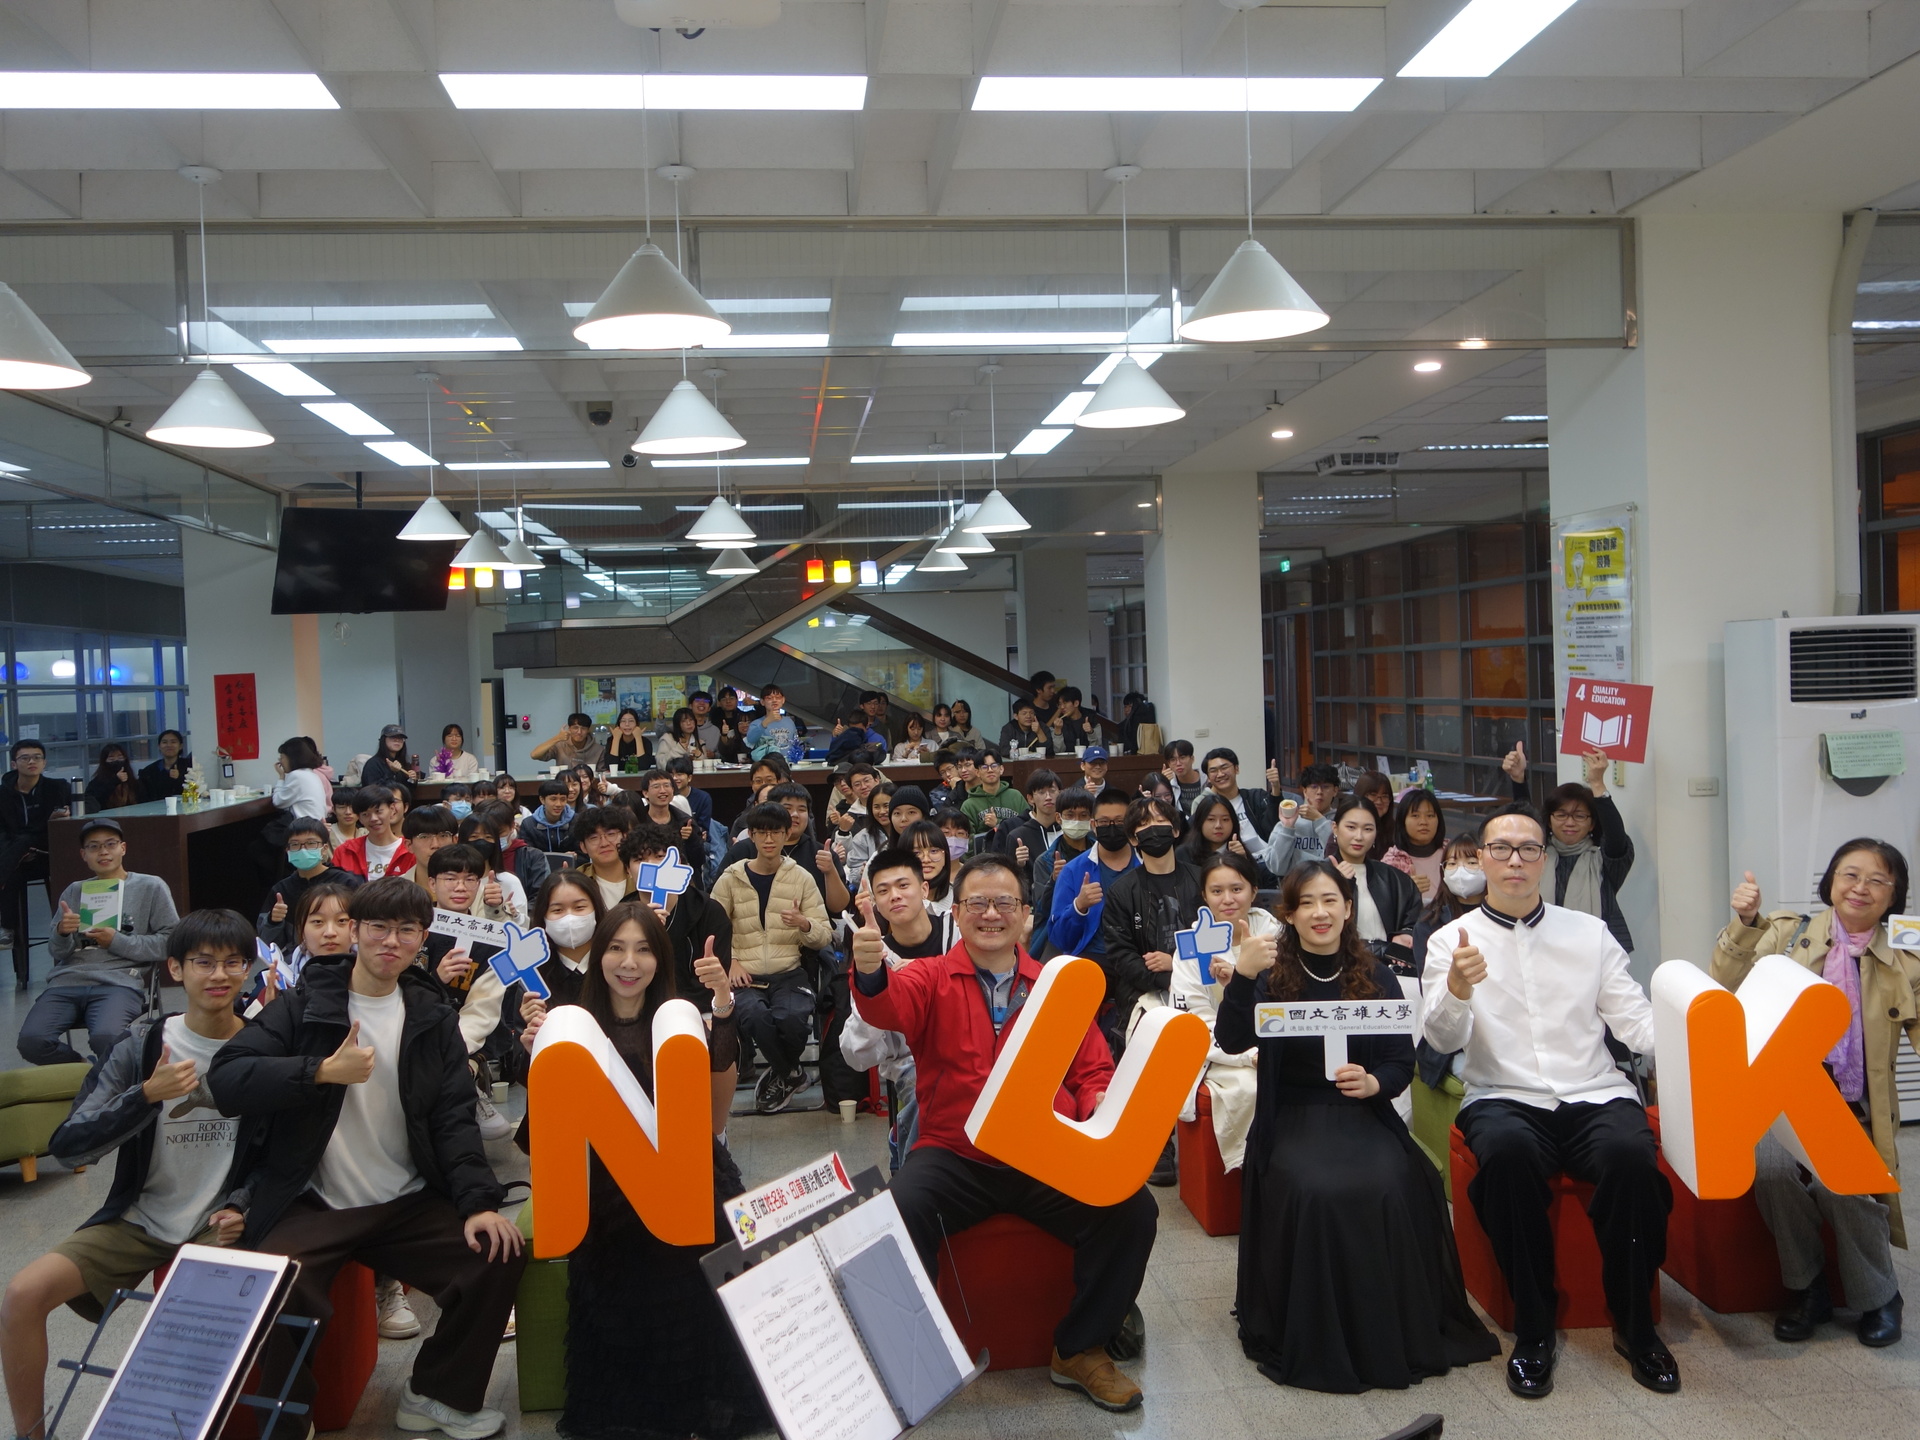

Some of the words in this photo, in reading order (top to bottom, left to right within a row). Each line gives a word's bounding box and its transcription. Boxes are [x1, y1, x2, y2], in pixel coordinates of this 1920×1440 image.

[1575, 683, 1586, 701] 4
[1592, 685, 1619, 696] QUALITY
[1591, 694, 1626, 706] EDUCATION
[1288, 1004, 1413, 1021] 國立高雄大學
[1362, 1023, 1392, 1031] Education
[528, 1010, 715, 1259] N
[966, 955, 1211, 1207] U
[1660, 960, 1903, 1200] K
[198, 1122, 231, 1132] ROOTS
[783, 1212, 797, 1223] EXACT
[797, 1202, 815, 1215] DIGITAL
[815, 1191, 836, 1206] PRINTING
